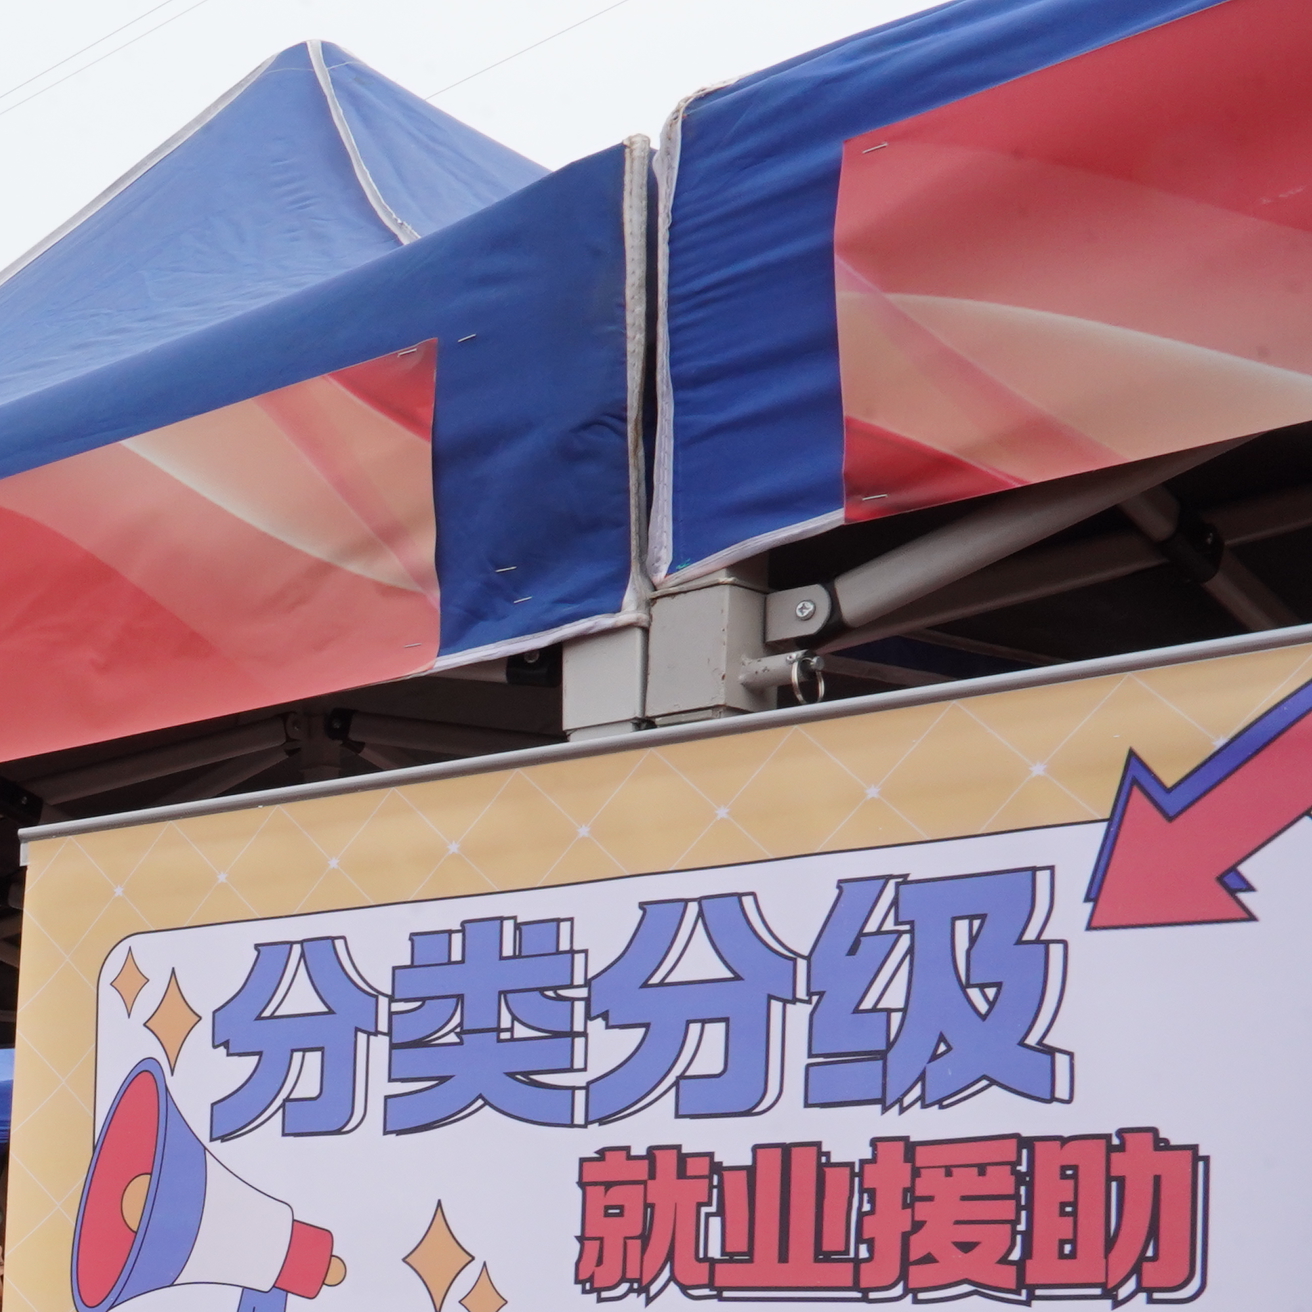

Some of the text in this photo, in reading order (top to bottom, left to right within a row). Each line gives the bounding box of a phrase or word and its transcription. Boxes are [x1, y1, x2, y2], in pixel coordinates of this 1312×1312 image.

[210, 865, 1075, 1140] 分类分级
[575, 1128, 1211, 1307] 就业援助
